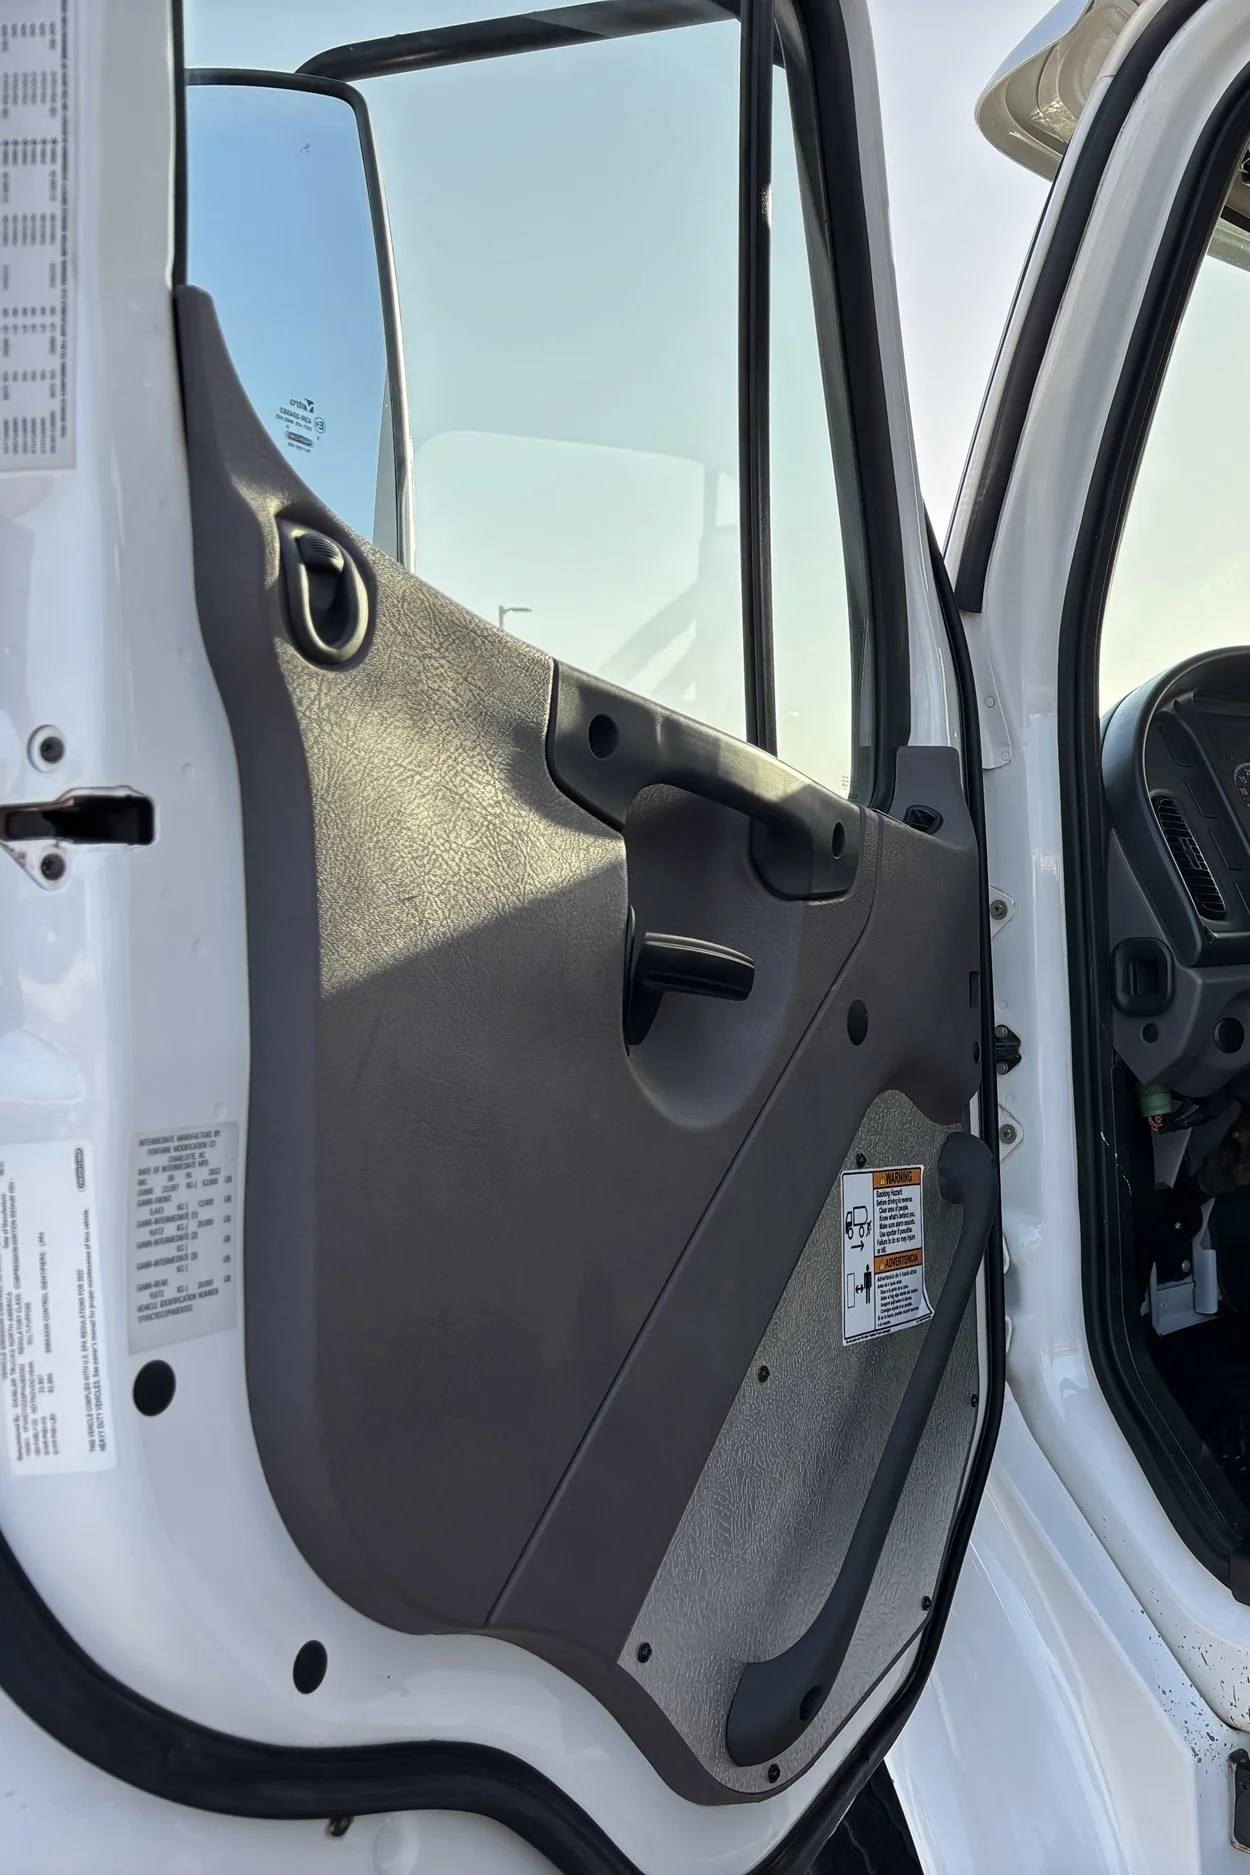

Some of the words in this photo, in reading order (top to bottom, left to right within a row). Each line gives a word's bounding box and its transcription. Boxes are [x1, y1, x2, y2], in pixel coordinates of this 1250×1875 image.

[1239, 776, 1247, 784] 15
[1240, 787, 1248, 795] 10
[886, 1171, 912, 1184] WARNING
[886, 1254, 918, 1268] ADVERTENCIA
[78, 1297, 87, 1338] REGULATIONS
[80, 1340, 88, 1352] EPA
[82, 1367, 91, 1381] WITH
[84, 1382, 92, 1412] COMPLIES
[85, 1413, 95, 1438] VEHICLE
[97, 1413, 105, 1429] DUTY
[88, 1439, 96, 1452] THIS
[98, 1430, 107, 1451] HEAVY
